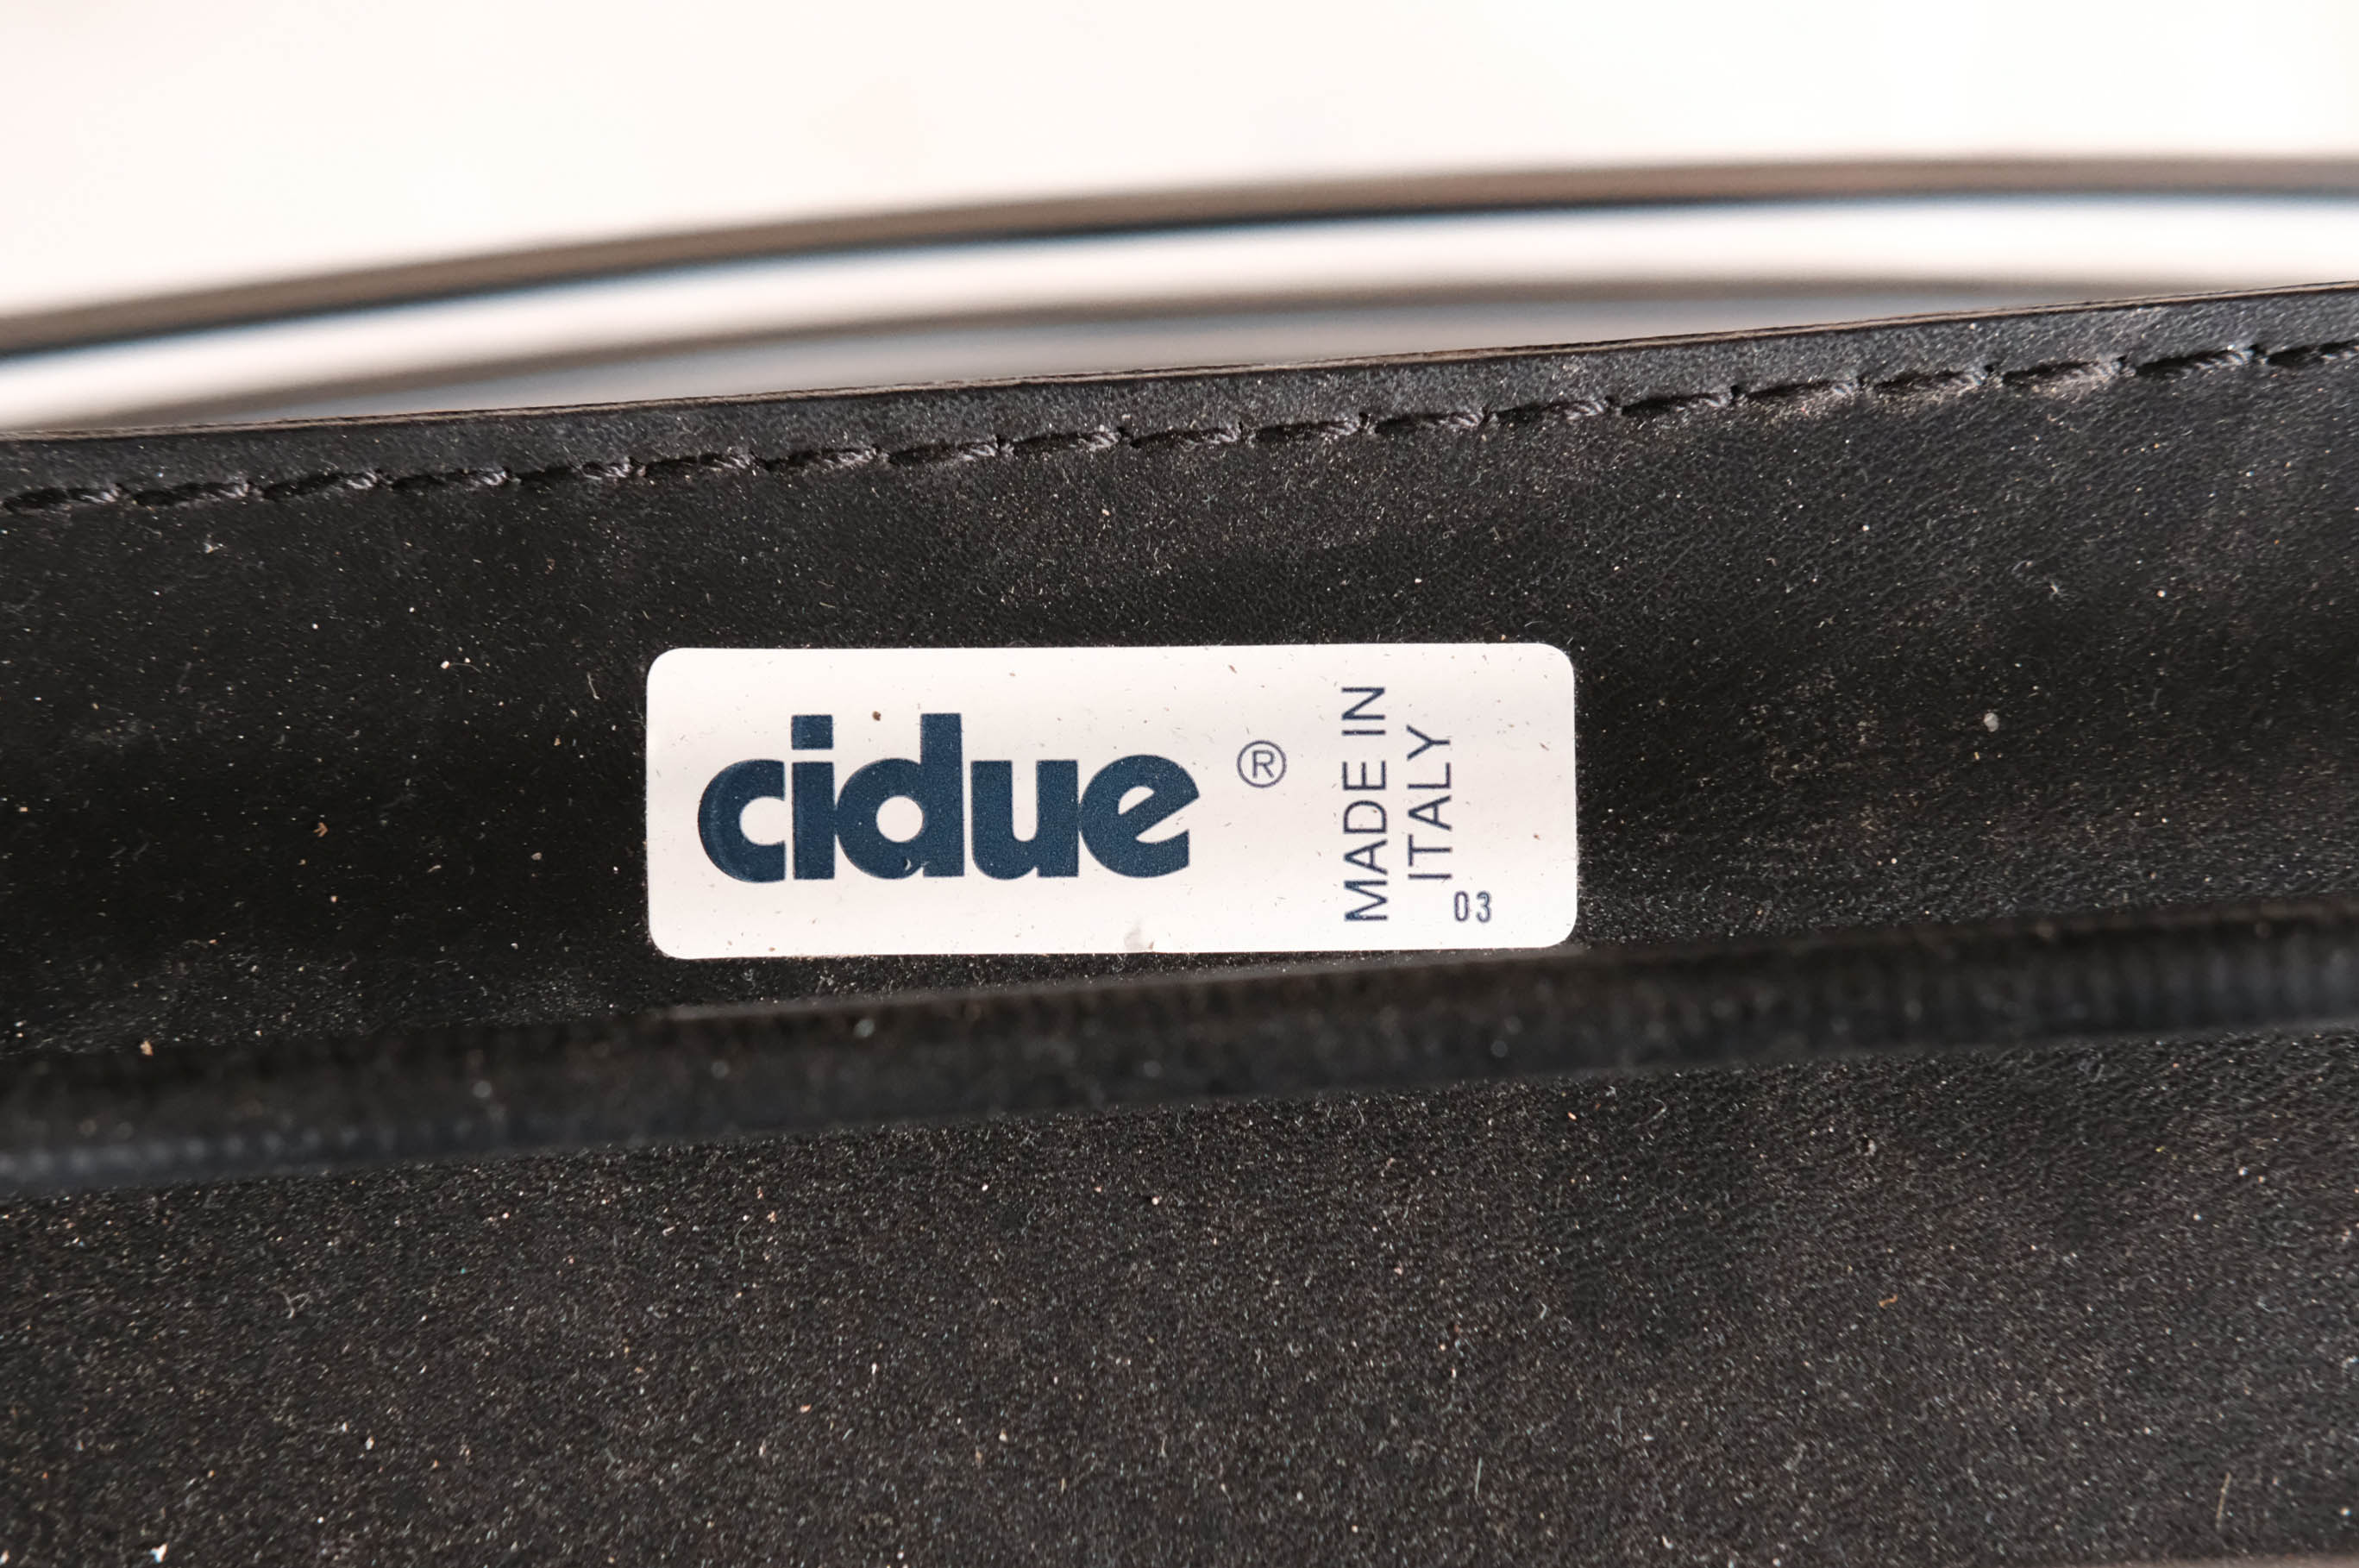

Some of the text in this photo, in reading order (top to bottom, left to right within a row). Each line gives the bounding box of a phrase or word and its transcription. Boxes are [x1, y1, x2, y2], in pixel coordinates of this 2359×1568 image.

[696, 712, 1200, 884] cidue
[1341, 687, 1388, 921] MADE IN
[1406, 724, 1452, 881] ITALY
[1453, 891, 1491, 923] 03
